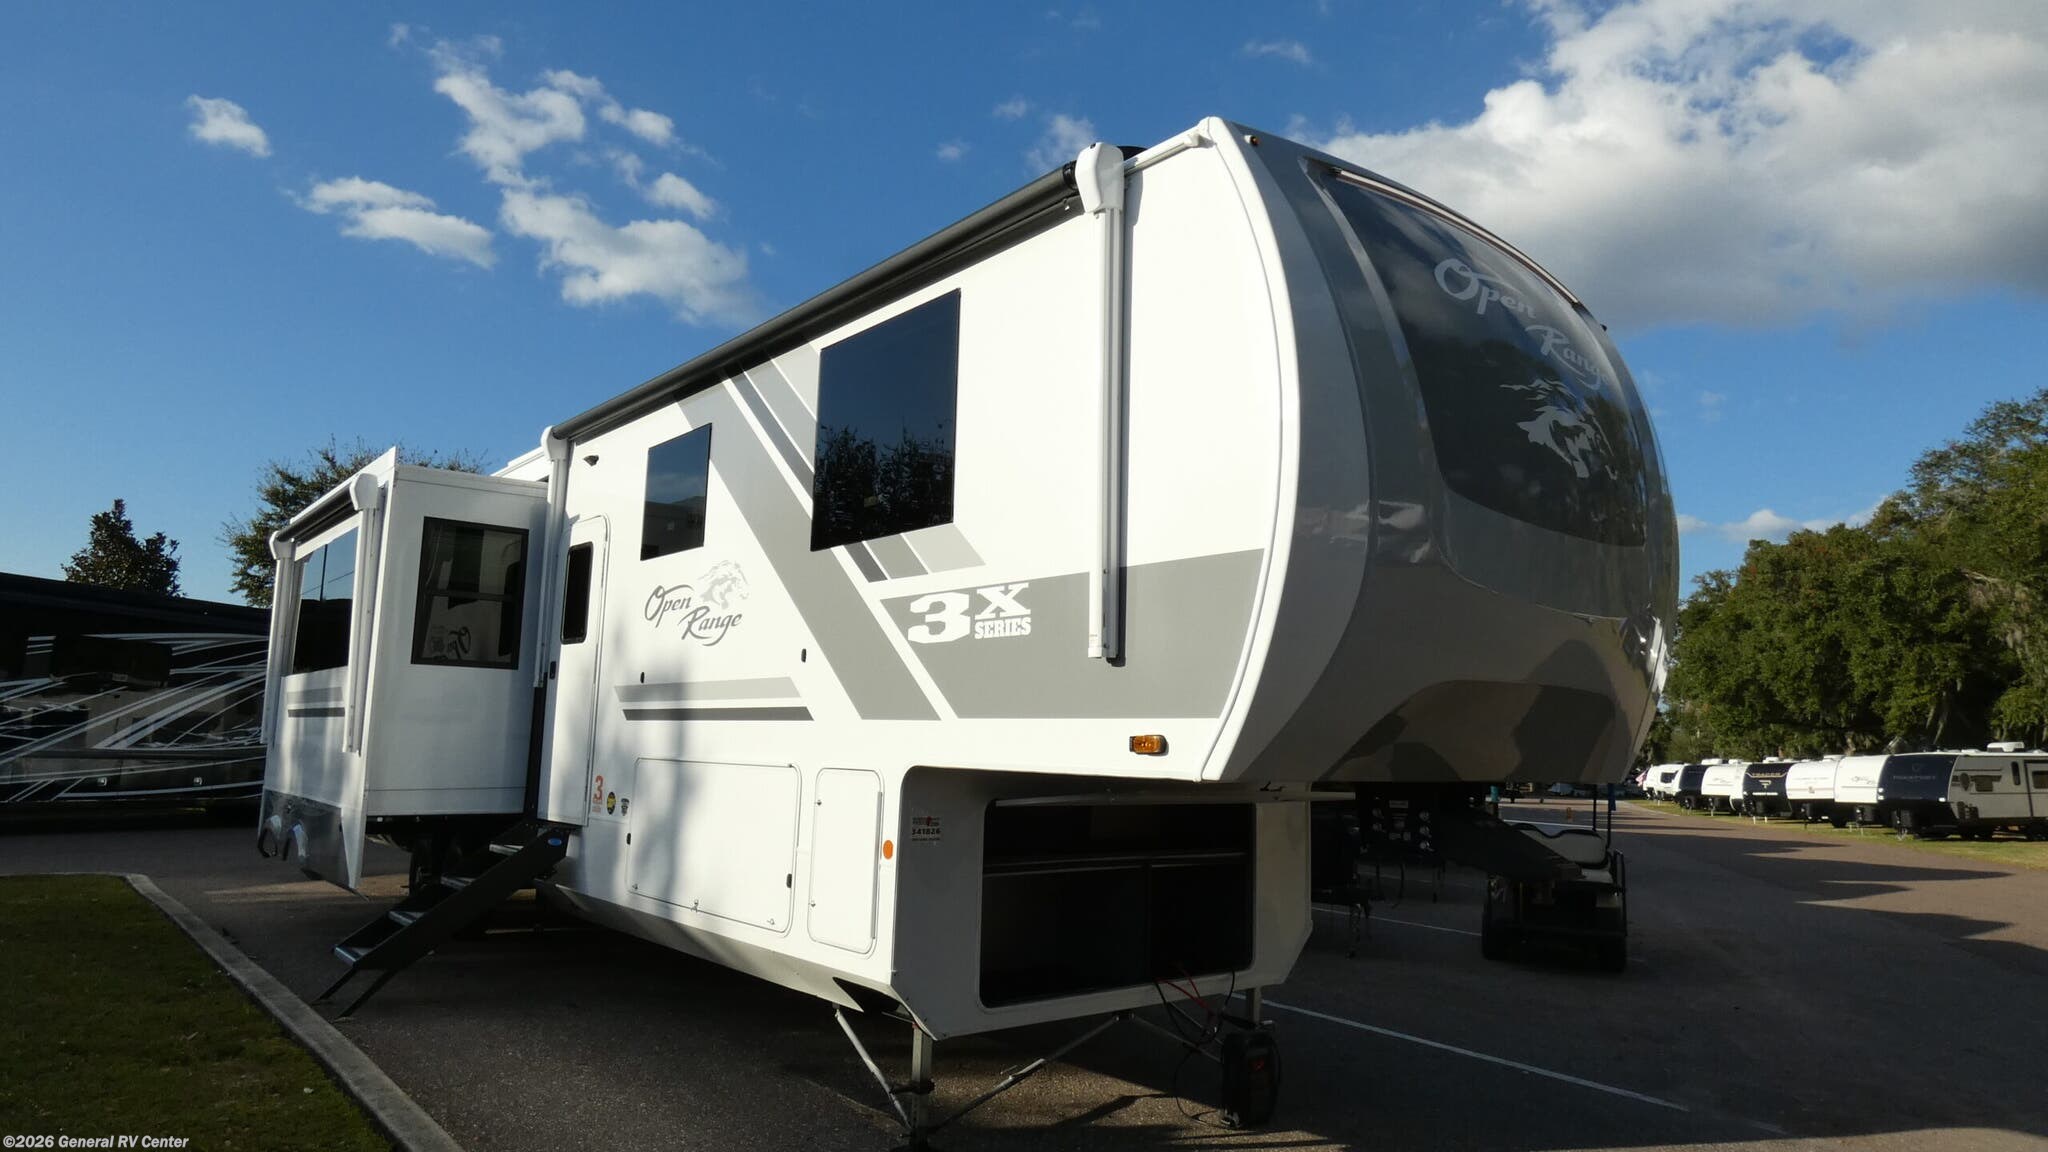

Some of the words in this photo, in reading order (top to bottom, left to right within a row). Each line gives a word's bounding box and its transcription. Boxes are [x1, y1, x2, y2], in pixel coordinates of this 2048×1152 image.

[1434, 258, 1536, 318] Open
[644, 584, 695, 629] Open
[677, 605, 743, 647] Range
[974, 616, 1032, 640] SERIES
